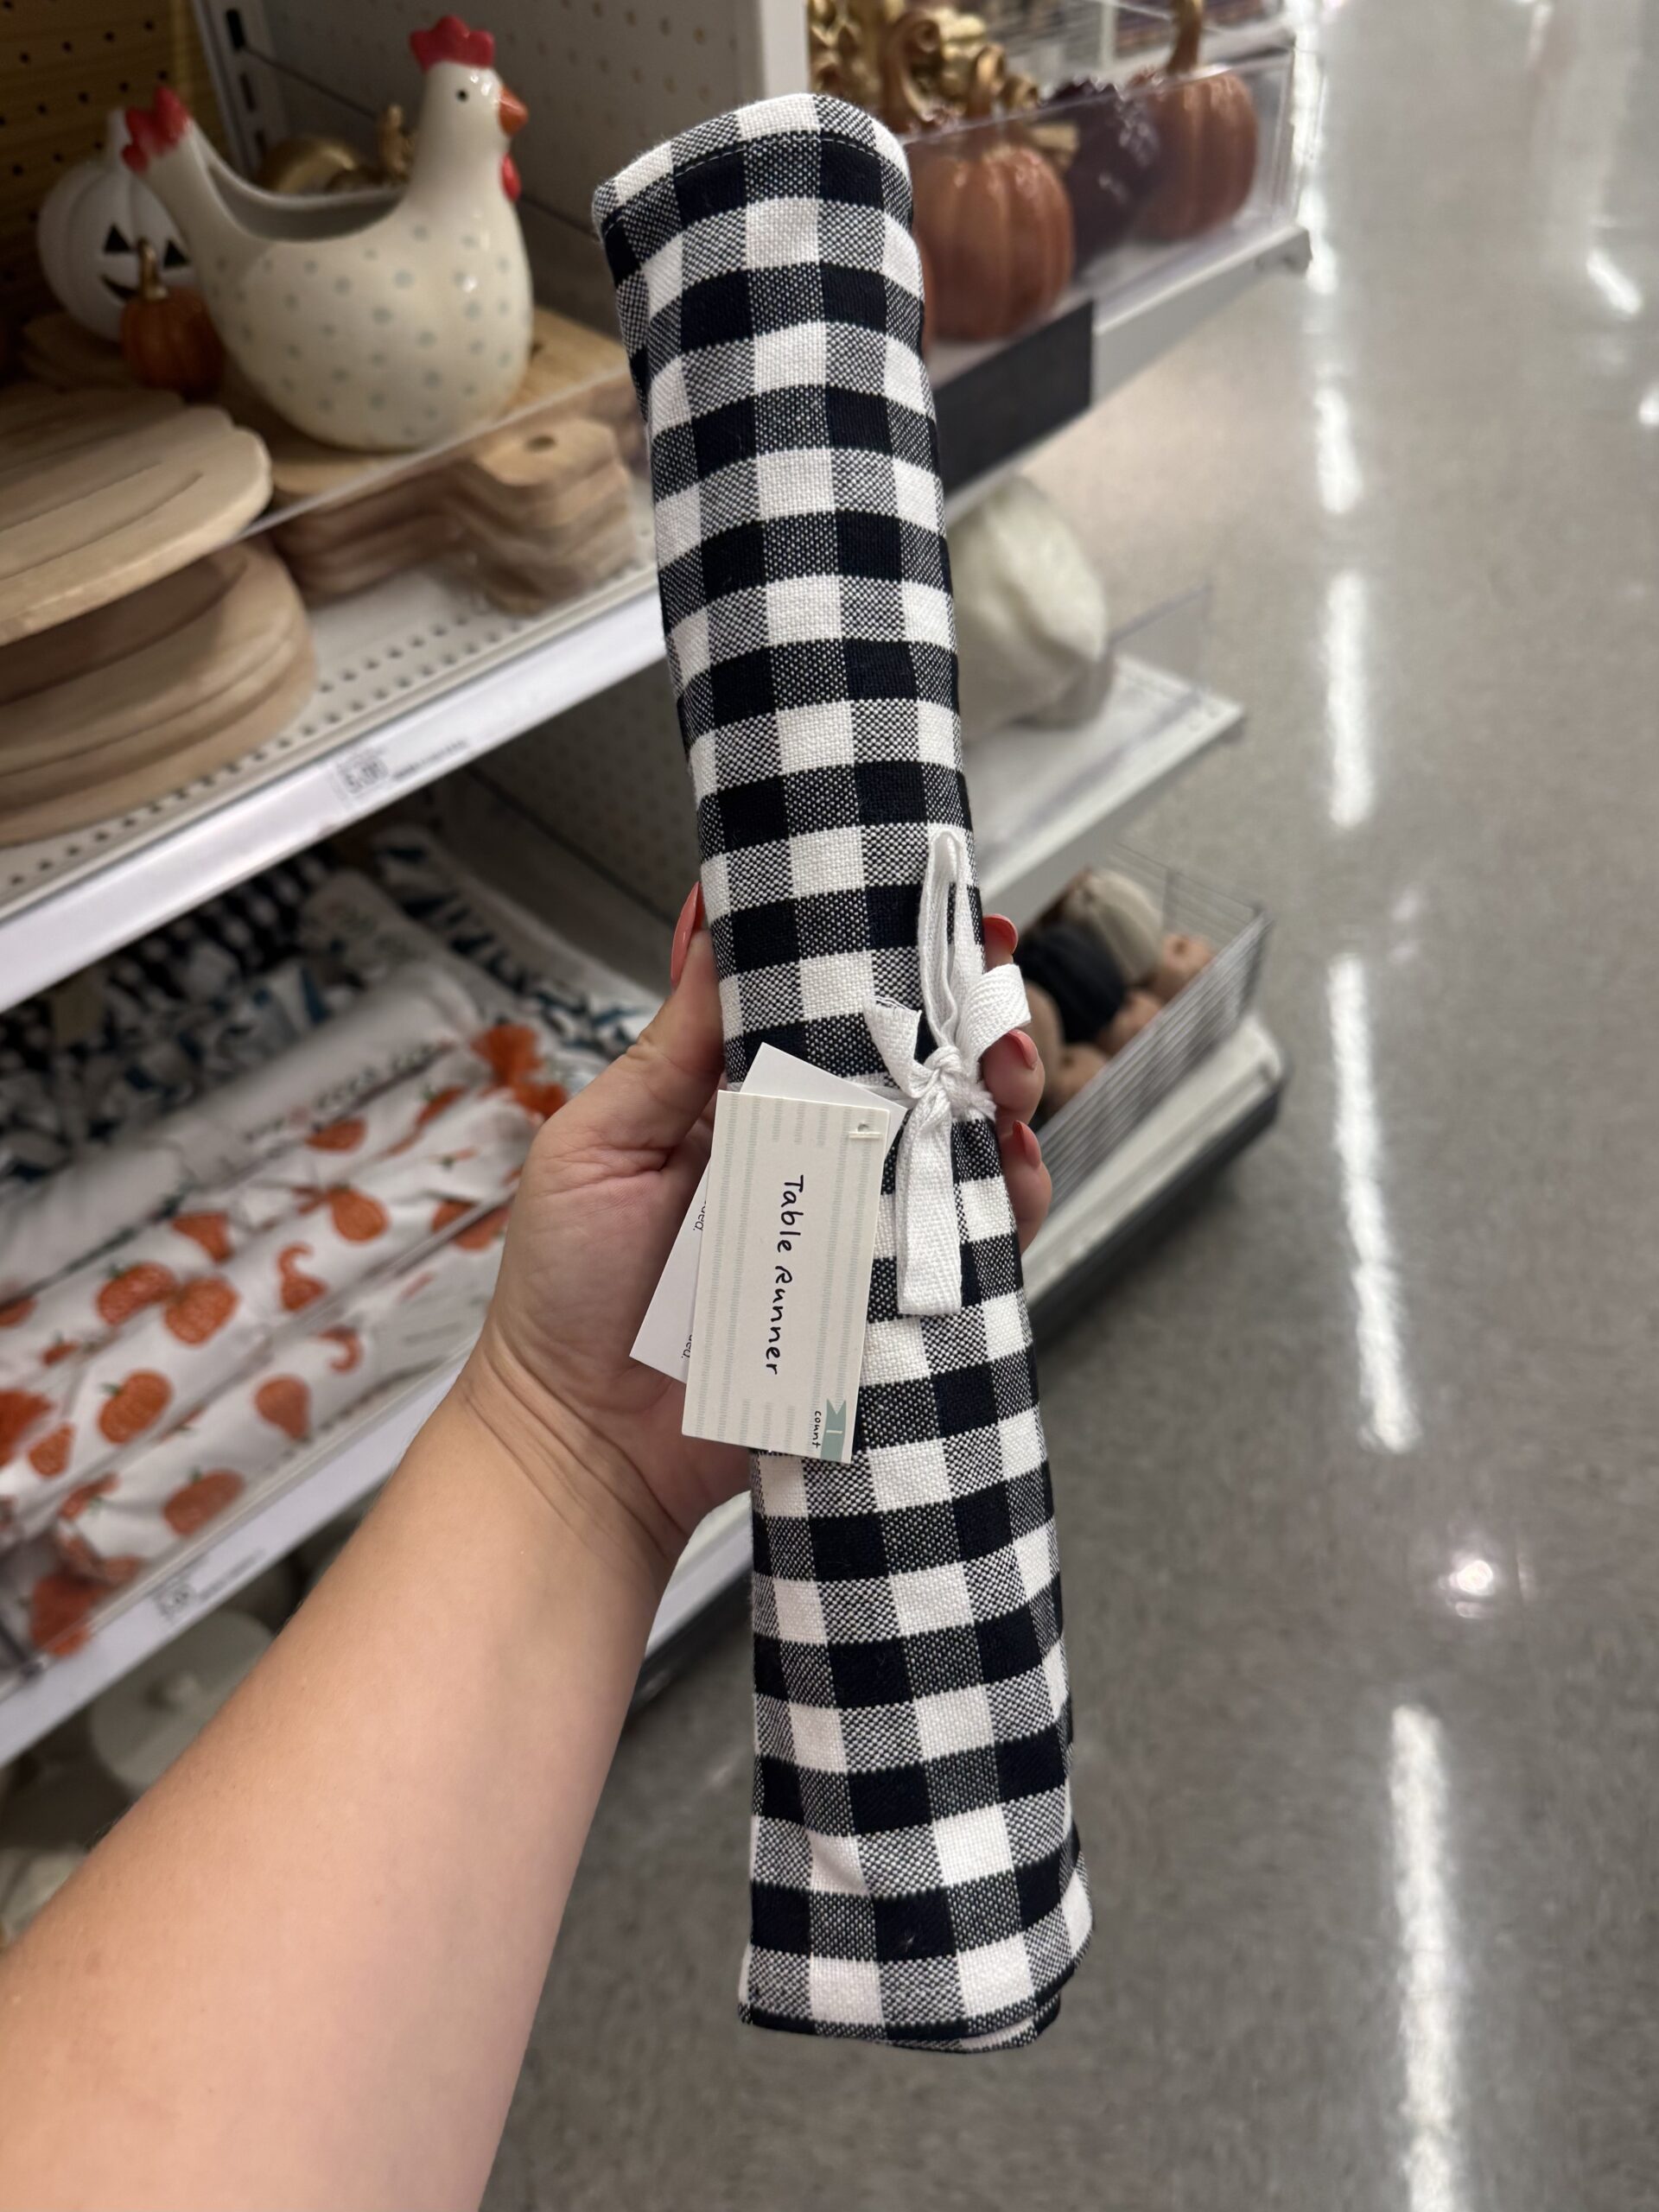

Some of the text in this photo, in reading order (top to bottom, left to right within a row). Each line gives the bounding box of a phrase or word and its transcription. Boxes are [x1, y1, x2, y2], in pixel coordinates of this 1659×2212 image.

[766, 1174, 804, 1375] Table Runner
[812, 1410, 822, 1448] count
